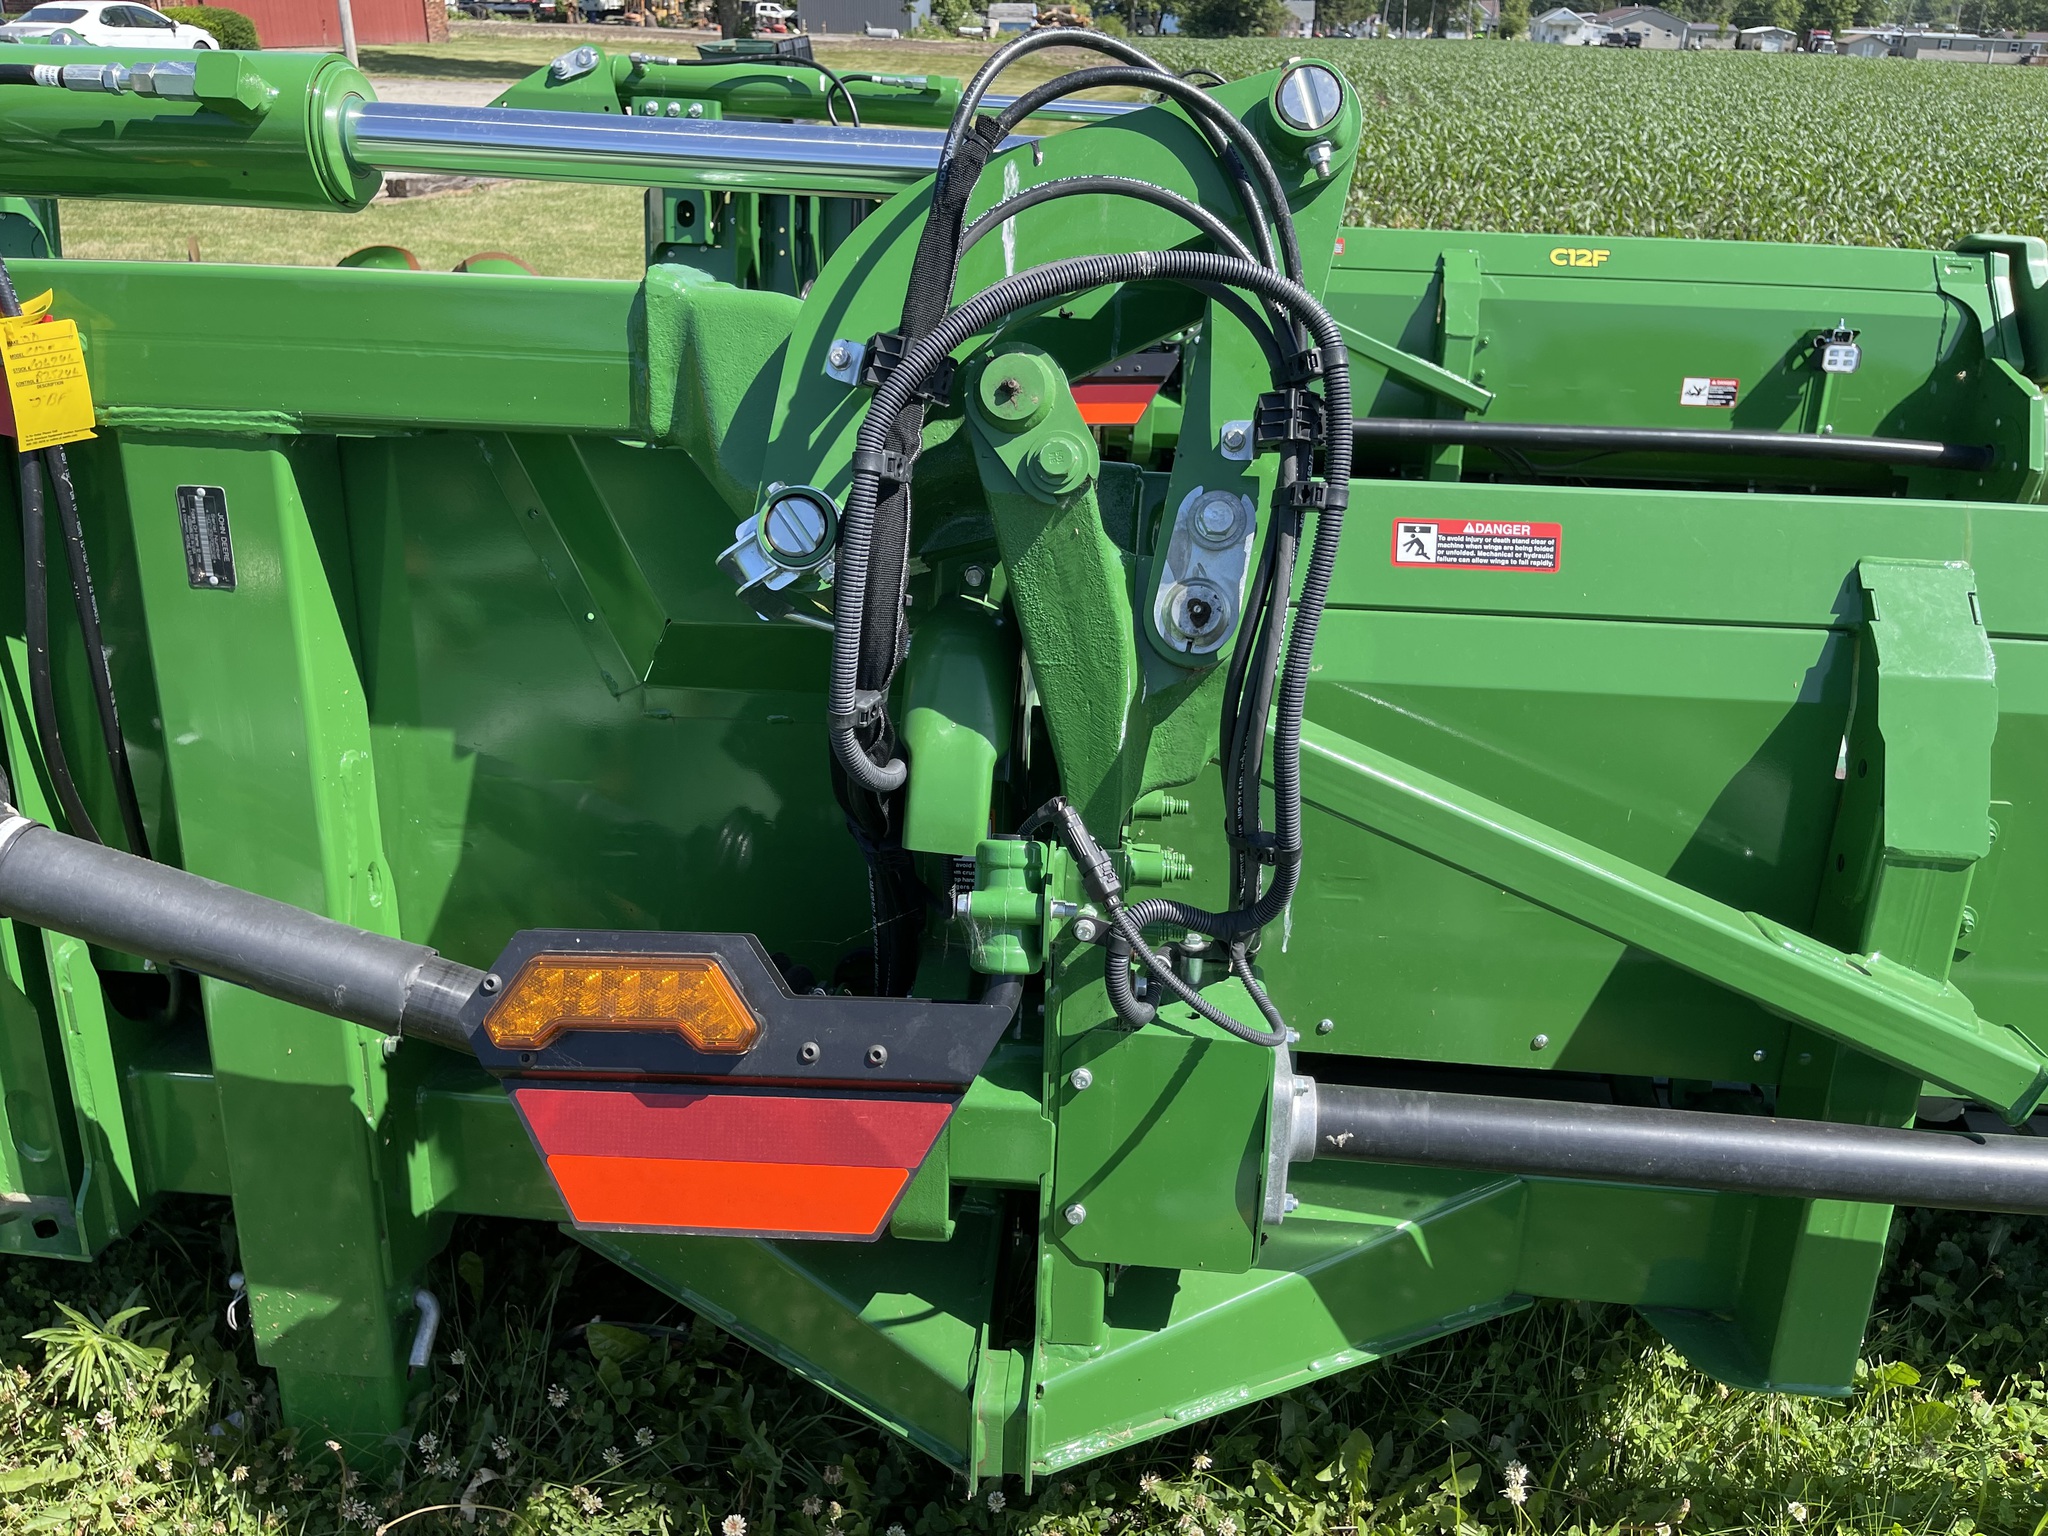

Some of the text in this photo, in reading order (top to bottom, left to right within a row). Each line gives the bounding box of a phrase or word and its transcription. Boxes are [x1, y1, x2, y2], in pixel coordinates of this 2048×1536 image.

[1549, 247, 1611, 268] C12F
[37, 381, 64, 389] DESCRIPTION
[1475, 523, 1530, 536] DANGER
[218, 513, 230, 562] JOHN DEERE
[1515, 545, 1533, 553] being
[1477, 550, 1513, 558] Mechanical
[1524, 552, 1554, 560] hydraulic
[1490, 558, 1509, 566] wings
[1530, 560, 1554, 568] rapidly.
